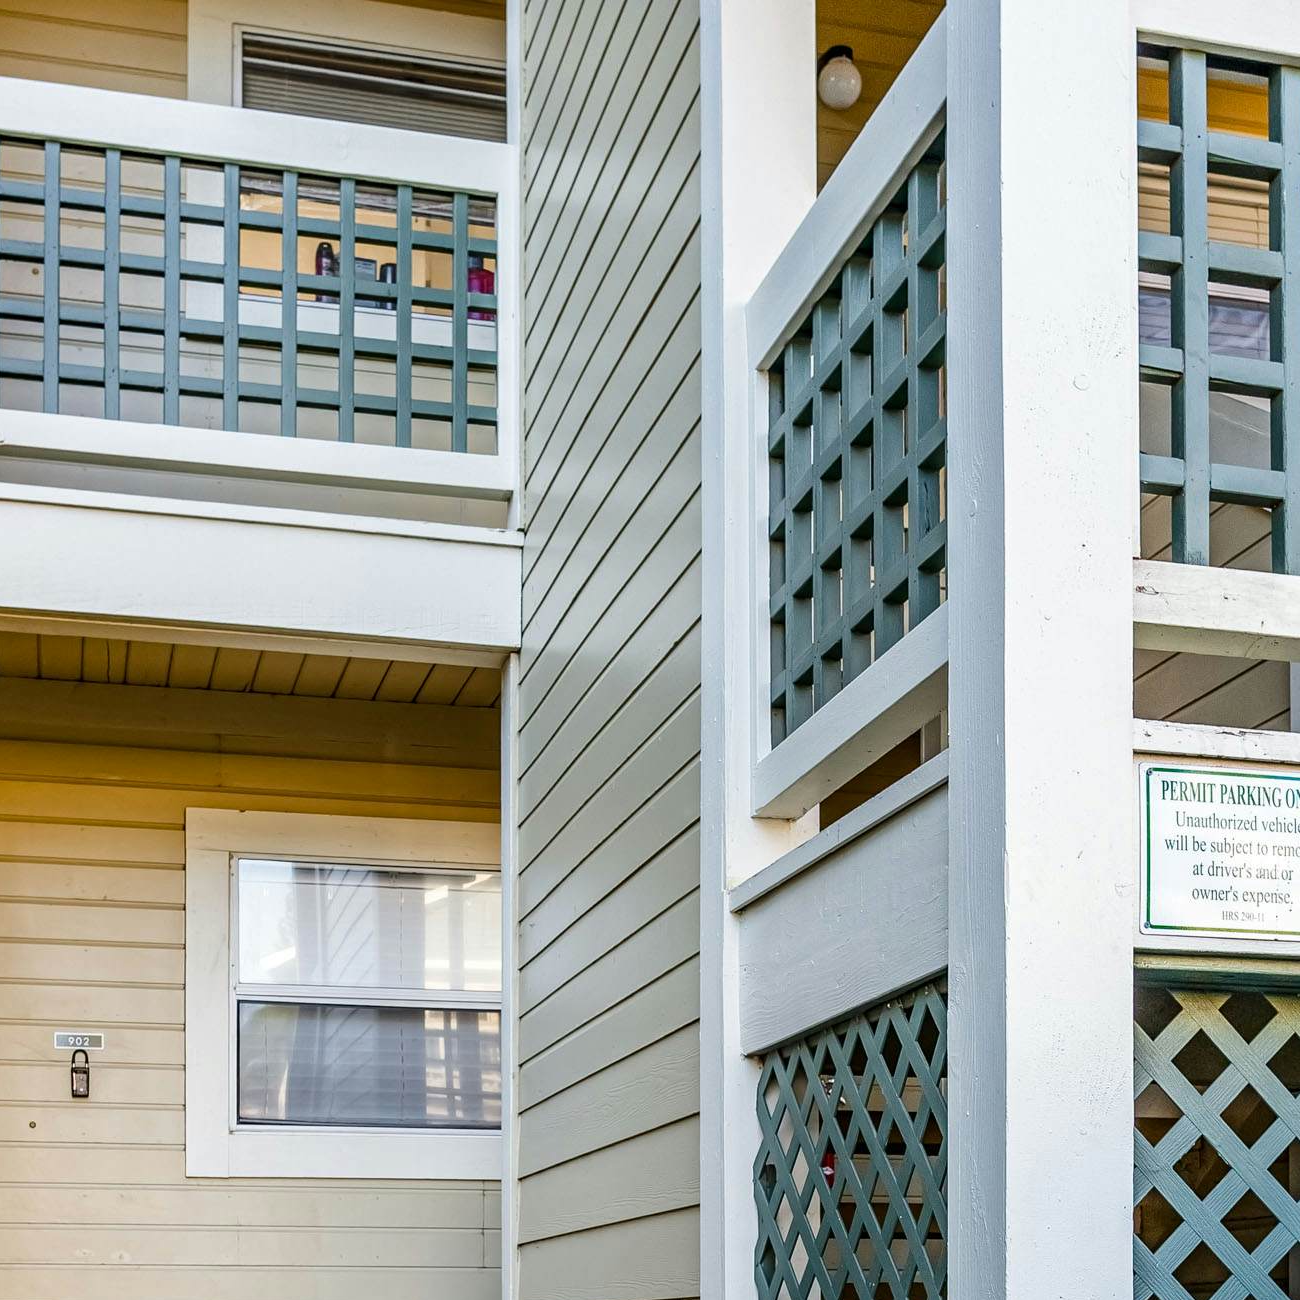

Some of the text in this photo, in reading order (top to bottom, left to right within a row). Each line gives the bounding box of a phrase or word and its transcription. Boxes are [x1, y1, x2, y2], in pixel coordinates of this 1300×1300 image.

[1161, 780, 1216, 804] PERMIT
[1220, 784, 1281, 808] PARKING
[1175, 811, 1258, 832] Unauthorized
[1164, 835, 1188, 852] will
[1192, 835, 1207, 853] be
[1210, 837, 1253, 858] subject
[1256, 842, 1269, 856] to
[1192, 862, 1204, 876] at
[1207, 860, 1252, 878] driver's
[1191, 886, 1294, 907] owner's expense.
[1222, 910, 1239, 921] HRS
[68, 1036, 90, 1046] 902
